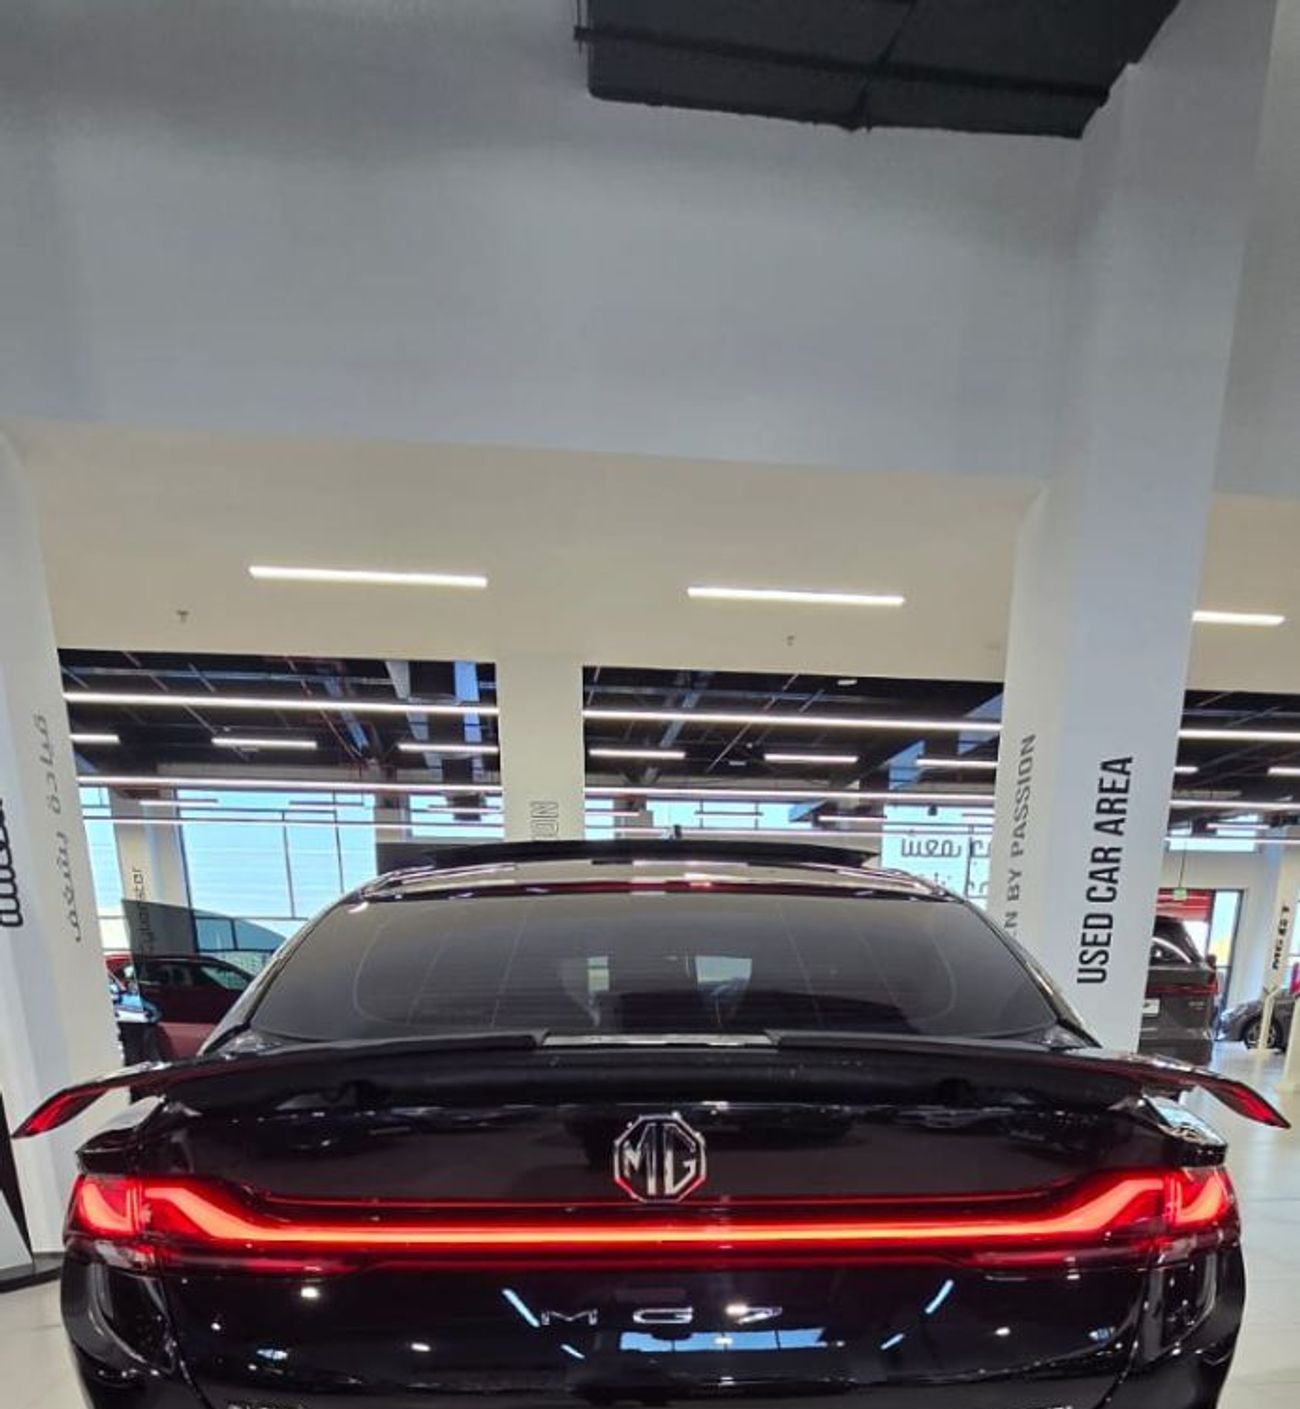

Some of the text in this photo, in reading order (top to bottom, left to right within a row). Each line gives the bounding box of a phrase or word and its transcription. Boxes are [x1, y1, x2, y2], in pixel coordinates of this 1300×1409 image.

[1010, 734, 1036, 857] PASSION
[1007, 869, 1022, 901] BY
[1077, 756, 1133, 984] USED CAR AREA
[619, 1119, 699, 1198] MG
